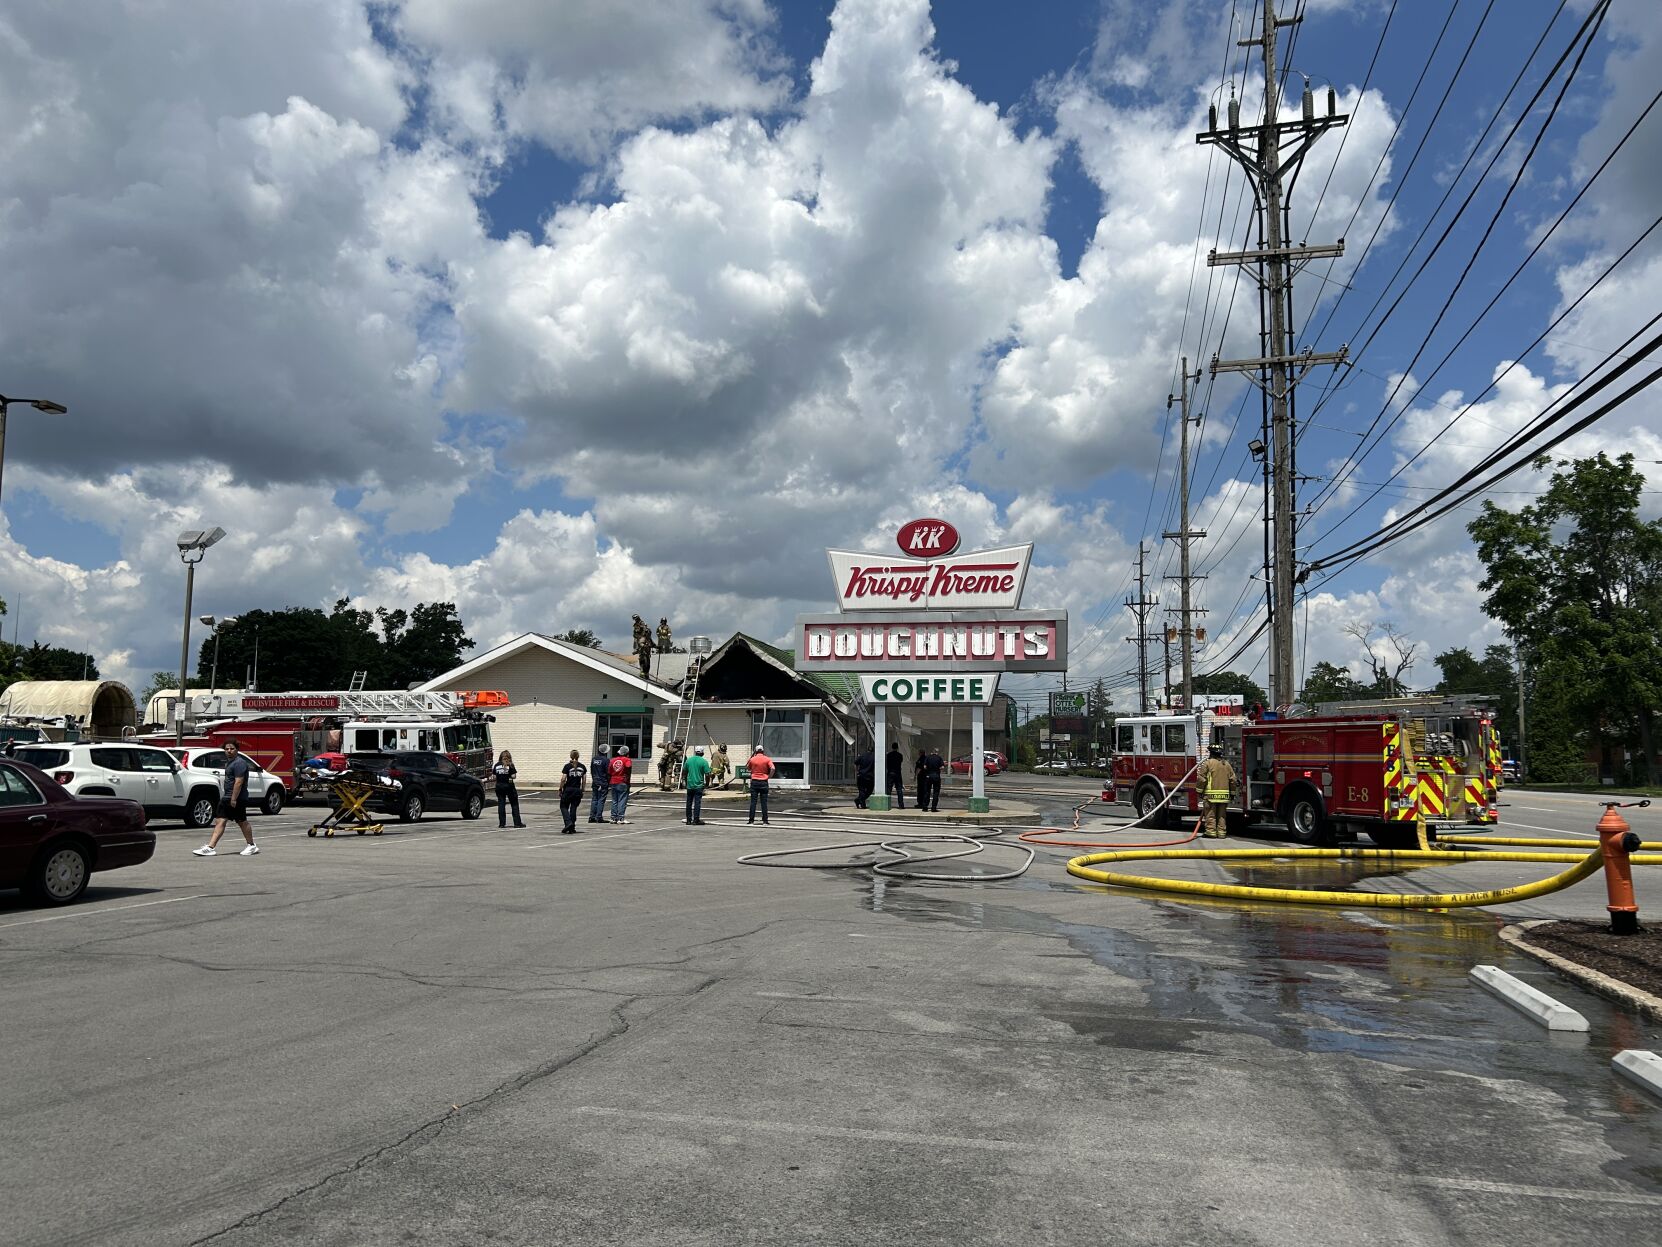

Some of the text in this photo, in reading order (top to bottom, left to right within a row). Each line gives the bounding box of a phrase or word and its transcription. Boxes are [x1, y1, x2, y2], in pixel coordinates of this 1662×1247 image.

[844, 562, 1019, 602] Krispy Kreme
[808, 625, 1049, 657] DOUGHNUTS
[872, 678, 983, 701] COFFEE
[244, 699, 282, 707] LOUISVILLE
[284, 699, 299, 707] FIRE
[301, 699, 307, 707] &
[308, 699, 335, 707] RESCUE
[1347, 786, 1369, 802] E-8
